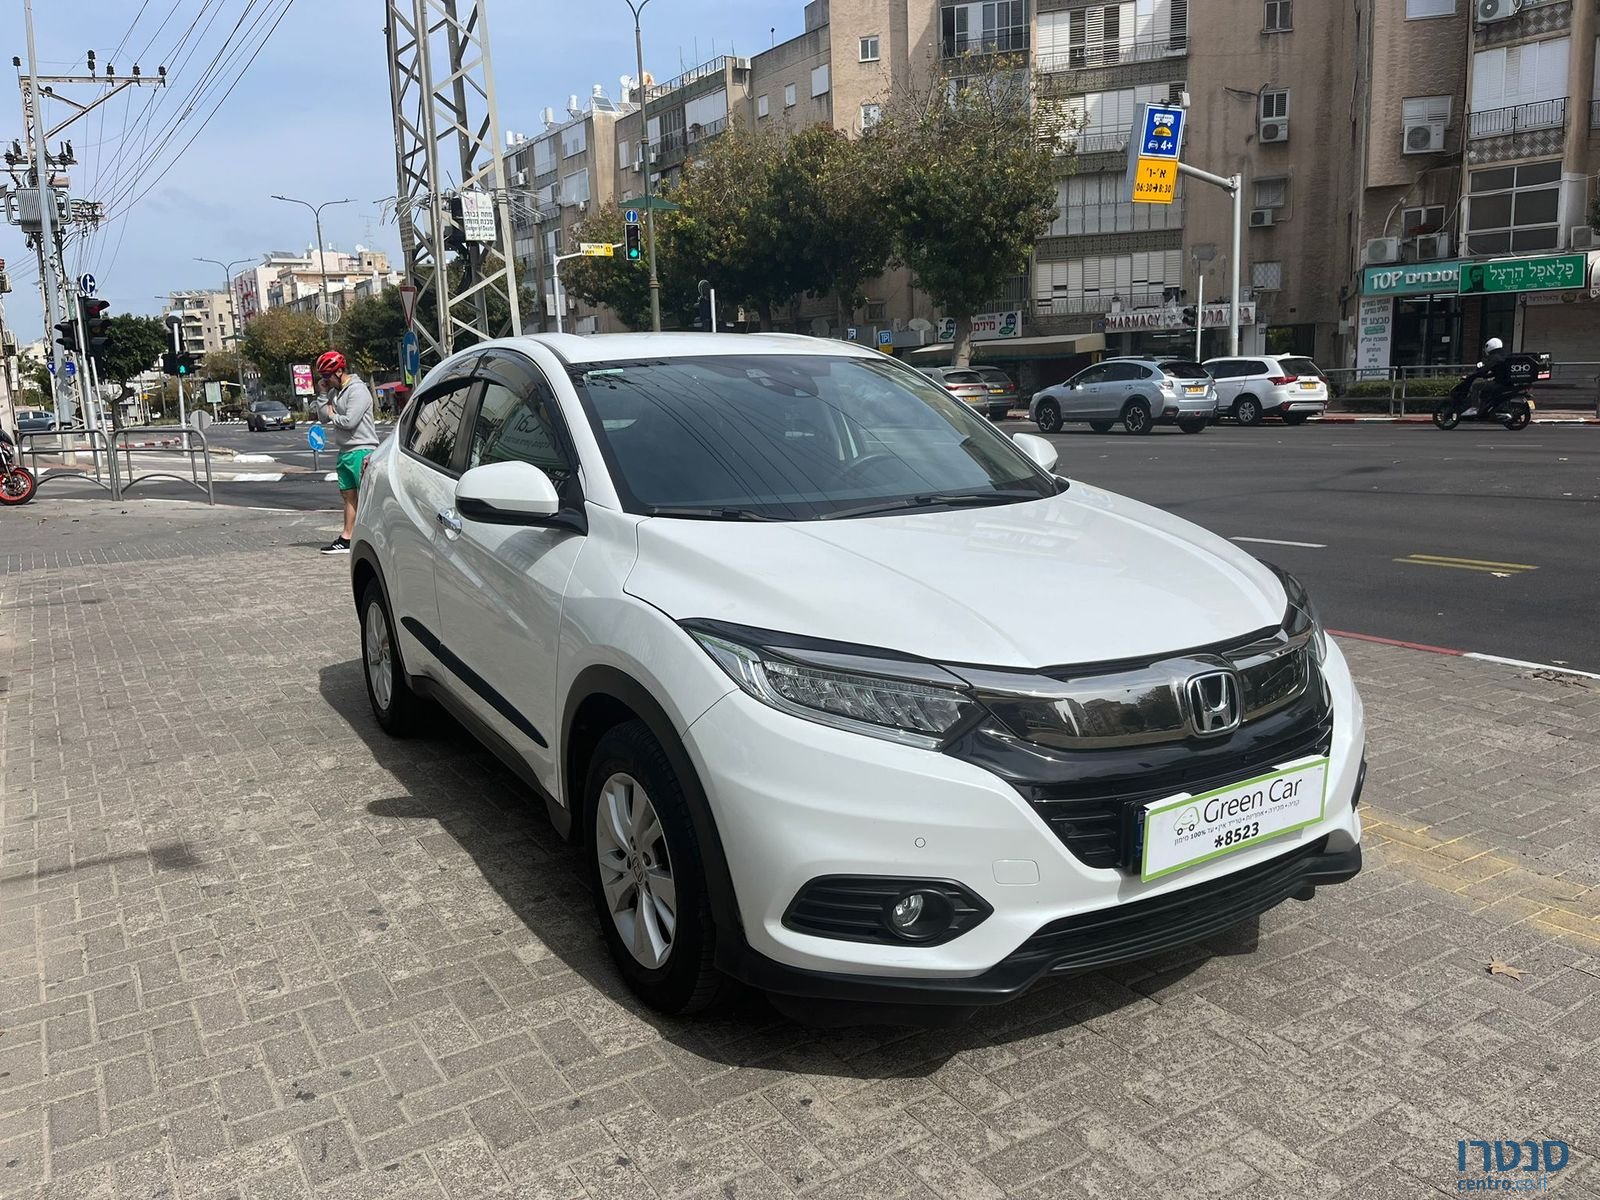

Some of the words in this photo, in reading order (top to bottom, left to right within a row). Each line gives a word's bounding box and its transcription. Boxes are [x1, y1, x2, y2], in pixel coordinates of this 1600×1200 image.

[1161, 140, 1173, 151] 4+
[1370, 271, 1403, 290] TOP
[1106, 314, 1160, 329] PHARMACY
[1511, 364, 1530, 372] SOHO
[1203, 790, 1263, 823] Green
[1268, 779, 1302, 802] Car
[1190, 830, 1206, 839] 100%
